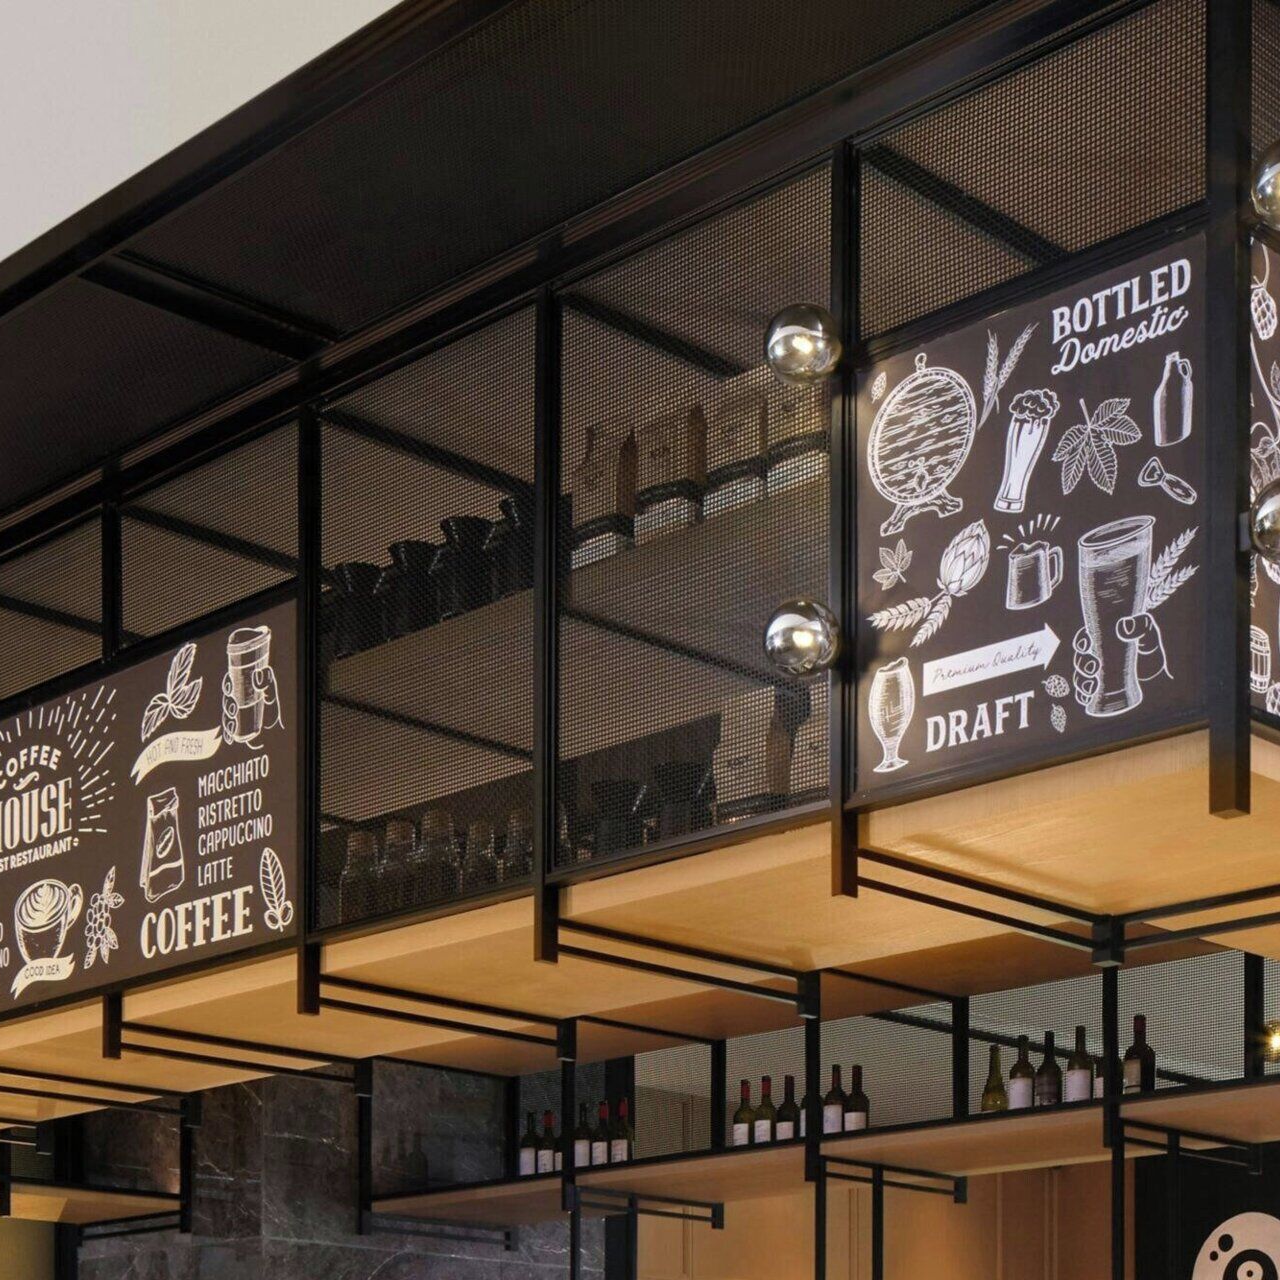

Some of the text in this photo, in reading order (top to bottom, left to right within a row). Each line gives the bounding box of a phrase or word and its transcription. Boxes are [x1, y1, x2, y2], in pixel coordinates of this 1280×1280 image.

[1052, 258, 1192, 345] BOTTLED
[1051, 305, 1189, 376] Domestic
[932, 641, 1041, 684] Premium Quality
[925, 690, 1035, 753] DRAFT
[146, 737, 204, 763] HOT AND FRESH
[198, 754, 270, 798] MACCHIATO
[198, 788, 262, 829] RISTRETTO
[9, 837, 73, 869] RESTAURANT
[198, 813, 273, 856] CAPPUCCINO
[198, 856, 233, 887] LATTE
[140, 884, 254, 959] COFFEE
[24, 964, 60, 979] GOOD IDEA
